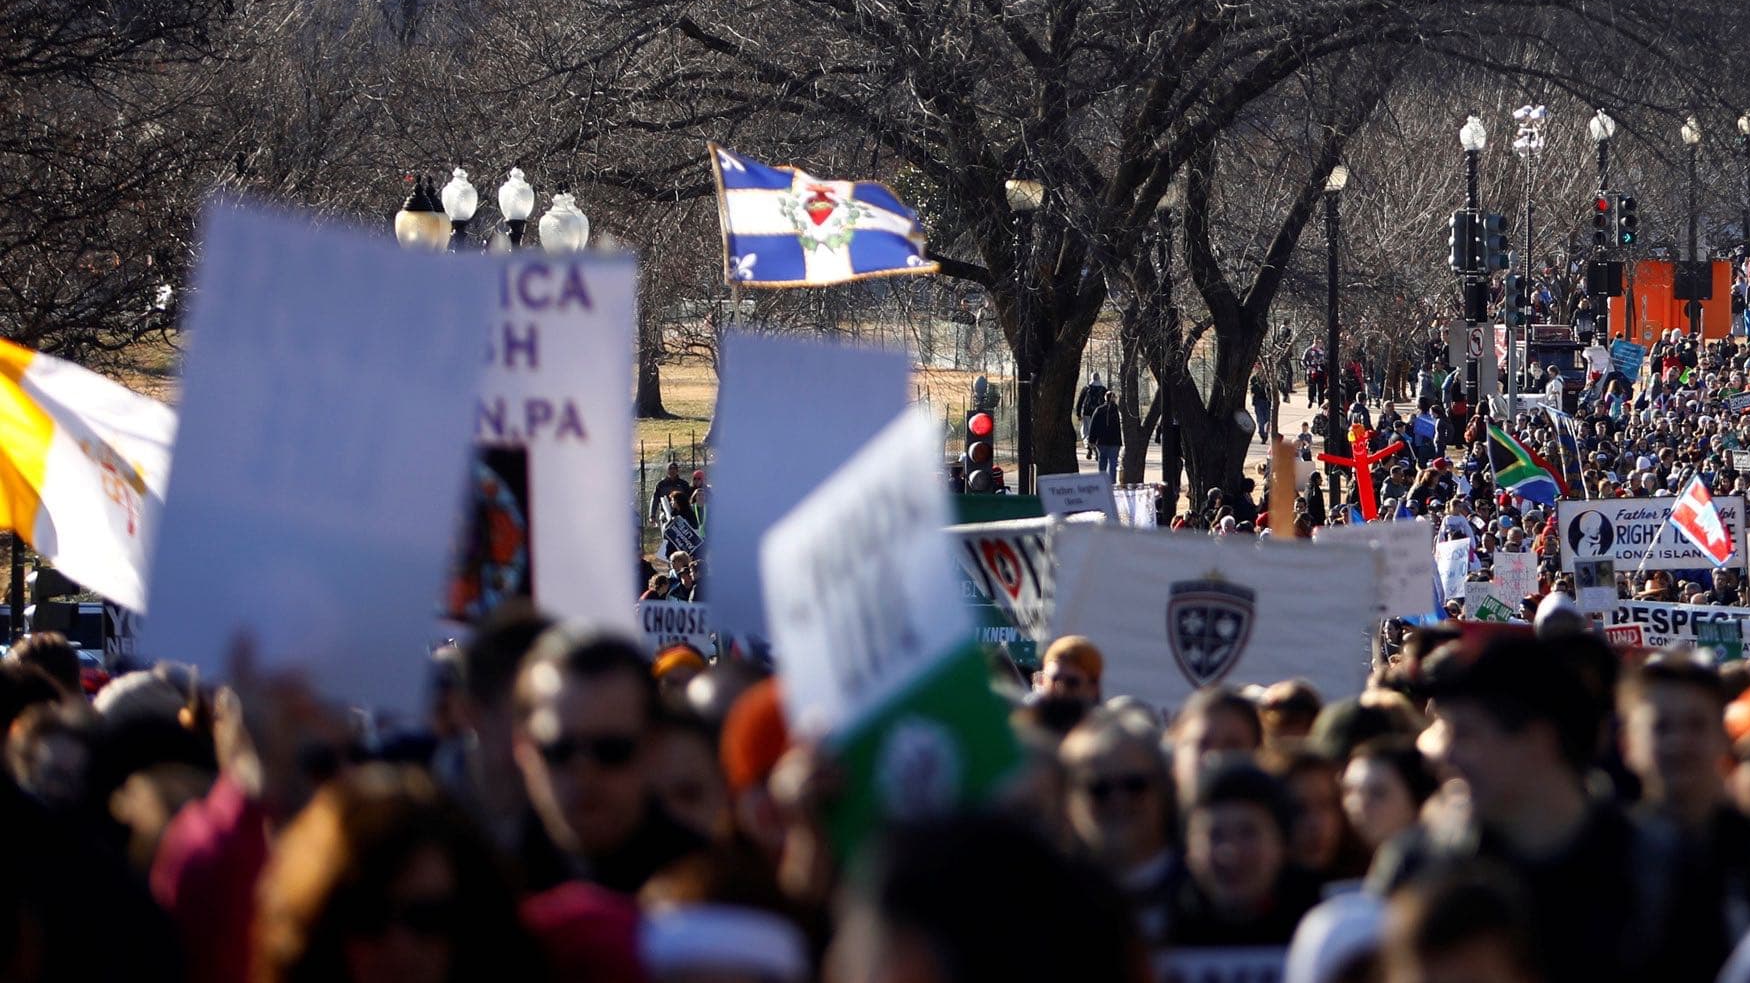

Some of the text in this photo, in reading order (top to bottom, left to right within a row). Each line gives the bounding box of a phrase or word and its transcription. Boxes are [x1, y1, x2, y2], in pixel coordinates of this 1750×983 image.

[1615, 508, 1658, 521] Father
[1616, 524, 1663, 546] RIGHT
[1615, 549, 1706, 560] LONG ISLAN
[643, 605, 705, 634] CHOOSE
[982, 626, 1018, 643] KNEW
